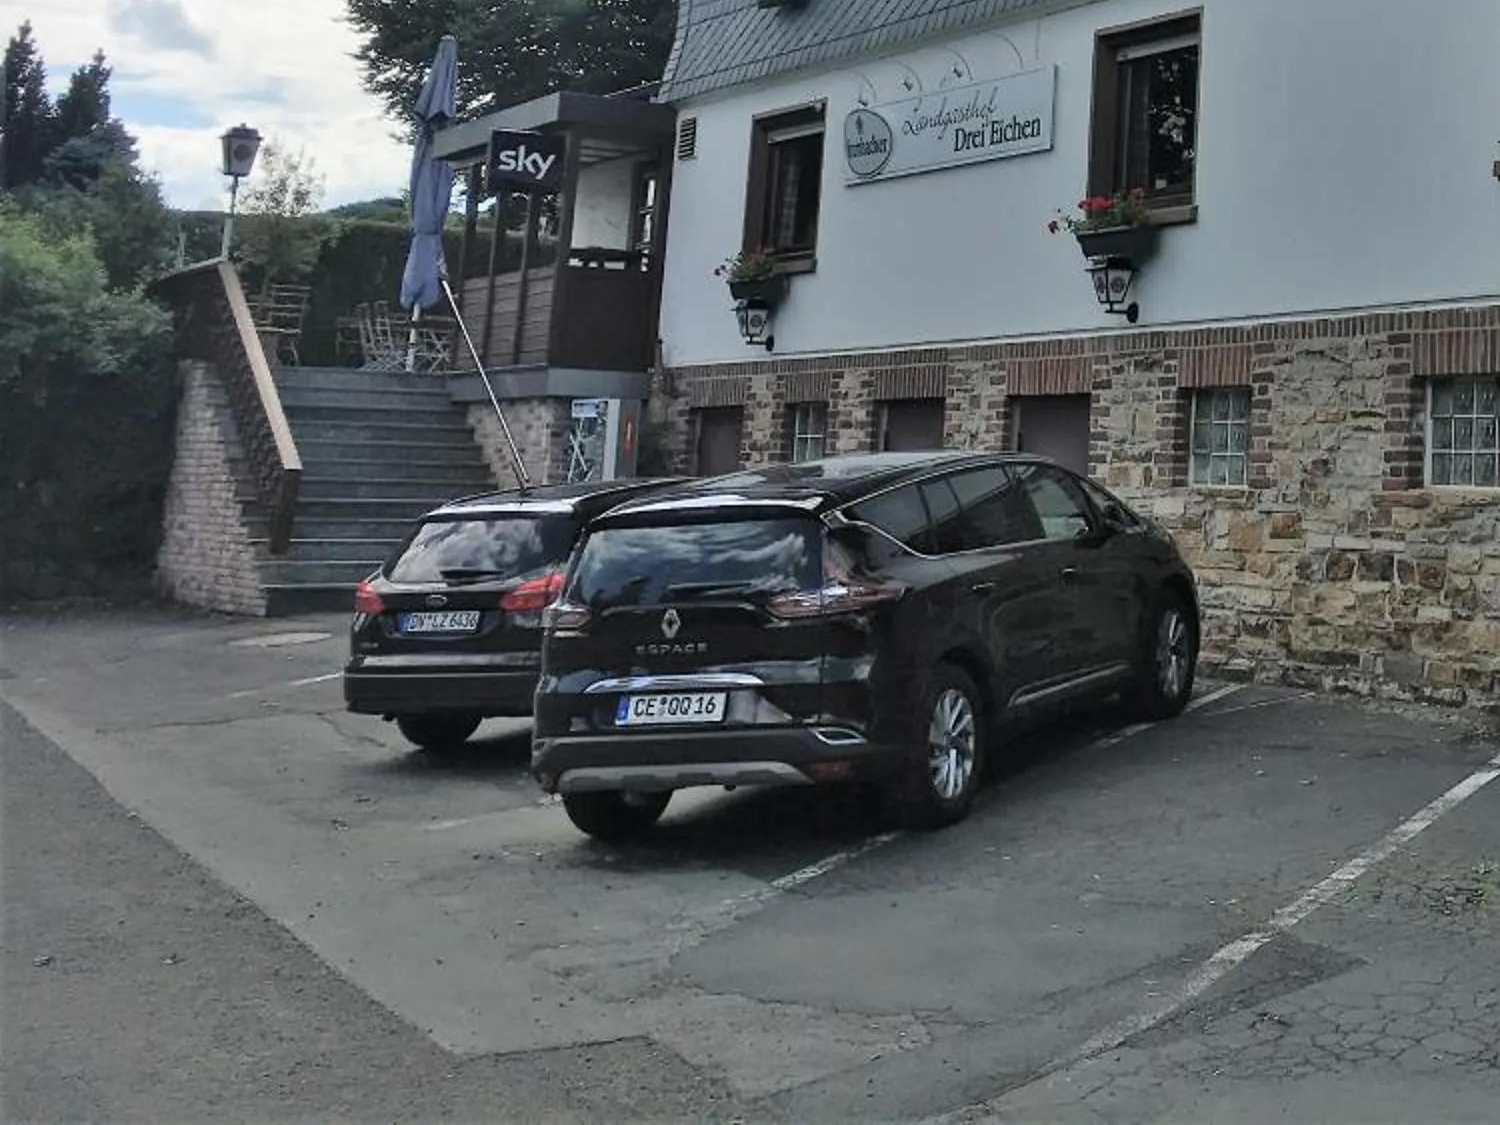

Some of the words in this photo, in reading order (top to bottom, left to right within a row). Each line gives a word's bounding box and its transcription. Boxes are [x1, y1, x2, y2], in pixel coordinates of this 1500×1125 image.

[953, 122, 986, 152] Drei
[989, 114, 1041, 146] Eichen
[498, 144, 556, 180] sky
[635, 642, 708, 655] ESPACE
[633, 698, 658, 717] CE
[667, 696, 693, 716] QQ
[694, 695, 717, 715] 16
